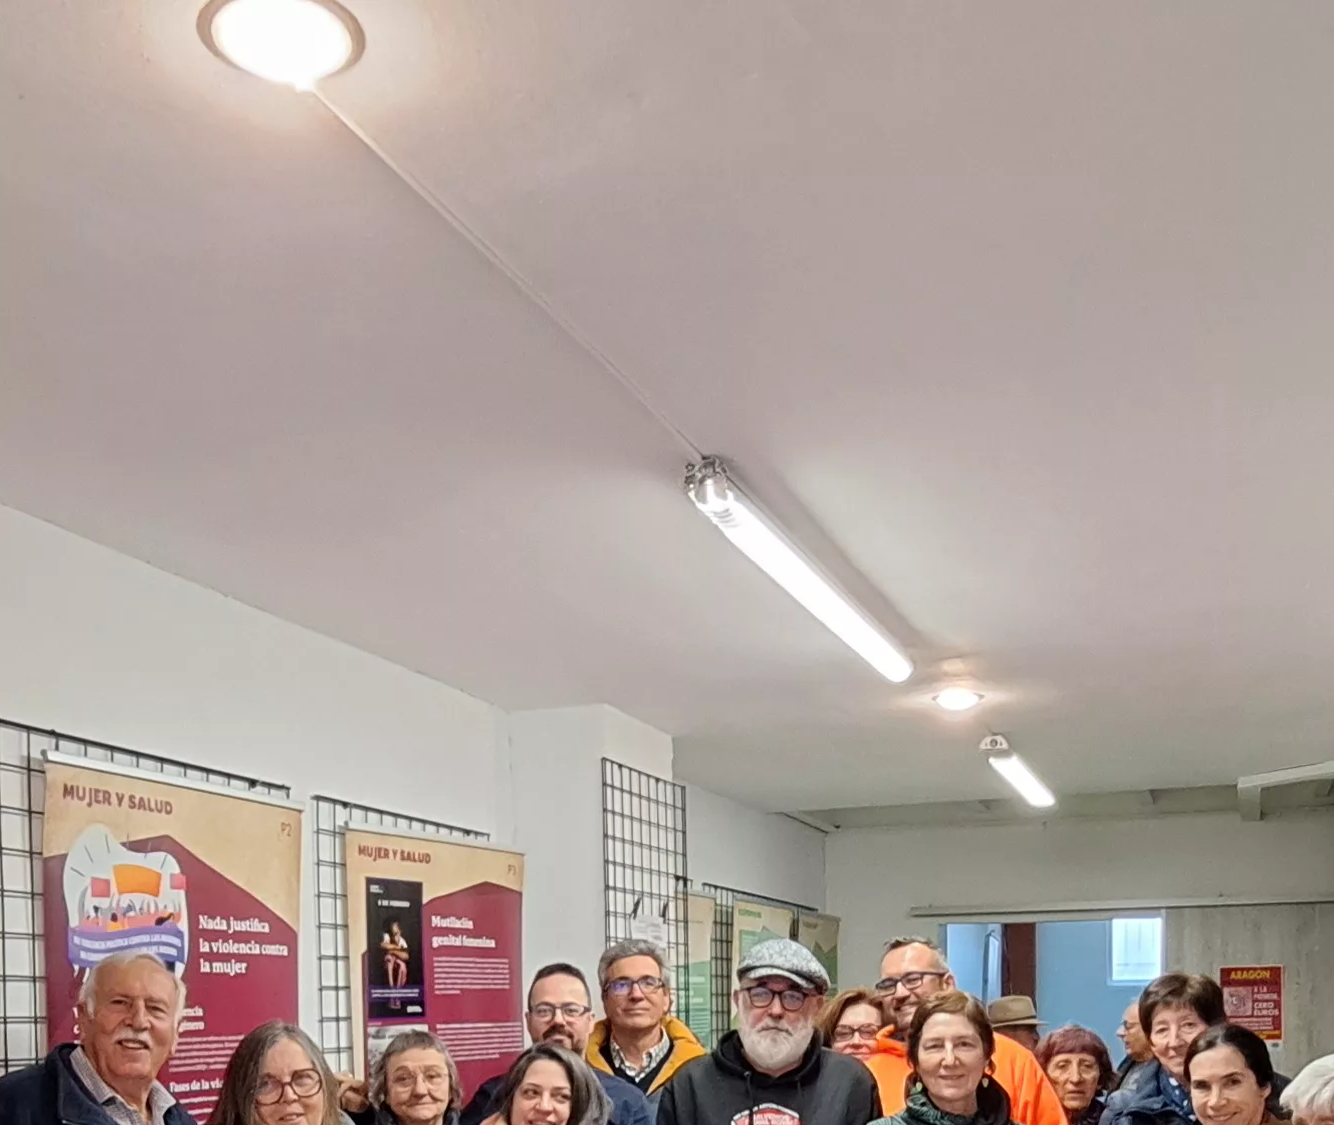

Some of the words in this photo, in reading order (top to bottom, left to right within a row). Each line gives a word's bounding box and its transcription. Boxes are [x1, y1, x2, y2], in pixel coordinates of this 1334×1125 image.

[62, 783, 112, 808] MUJER
[115, 792, 125, 807] Y
[128, 794, 173, 815] SALUD
[358, 844, 389, 862] MUJER
[392, 848, 398, 860] Y
[400, 849, 431, 864] SALUD
[198, 914, 227, 929] Nada
[228, 916, 270, 934] justifica
[199, 938, 210, 953] la
[211, 939, 260, 954] violencia
[261, 944, 288, 957] contra
[200, 958, 210, 973] la
[212, 959, 247, 976] mujer
[190, 1080, 200, 1090] de
[201, 1078, 209, 1090] la
